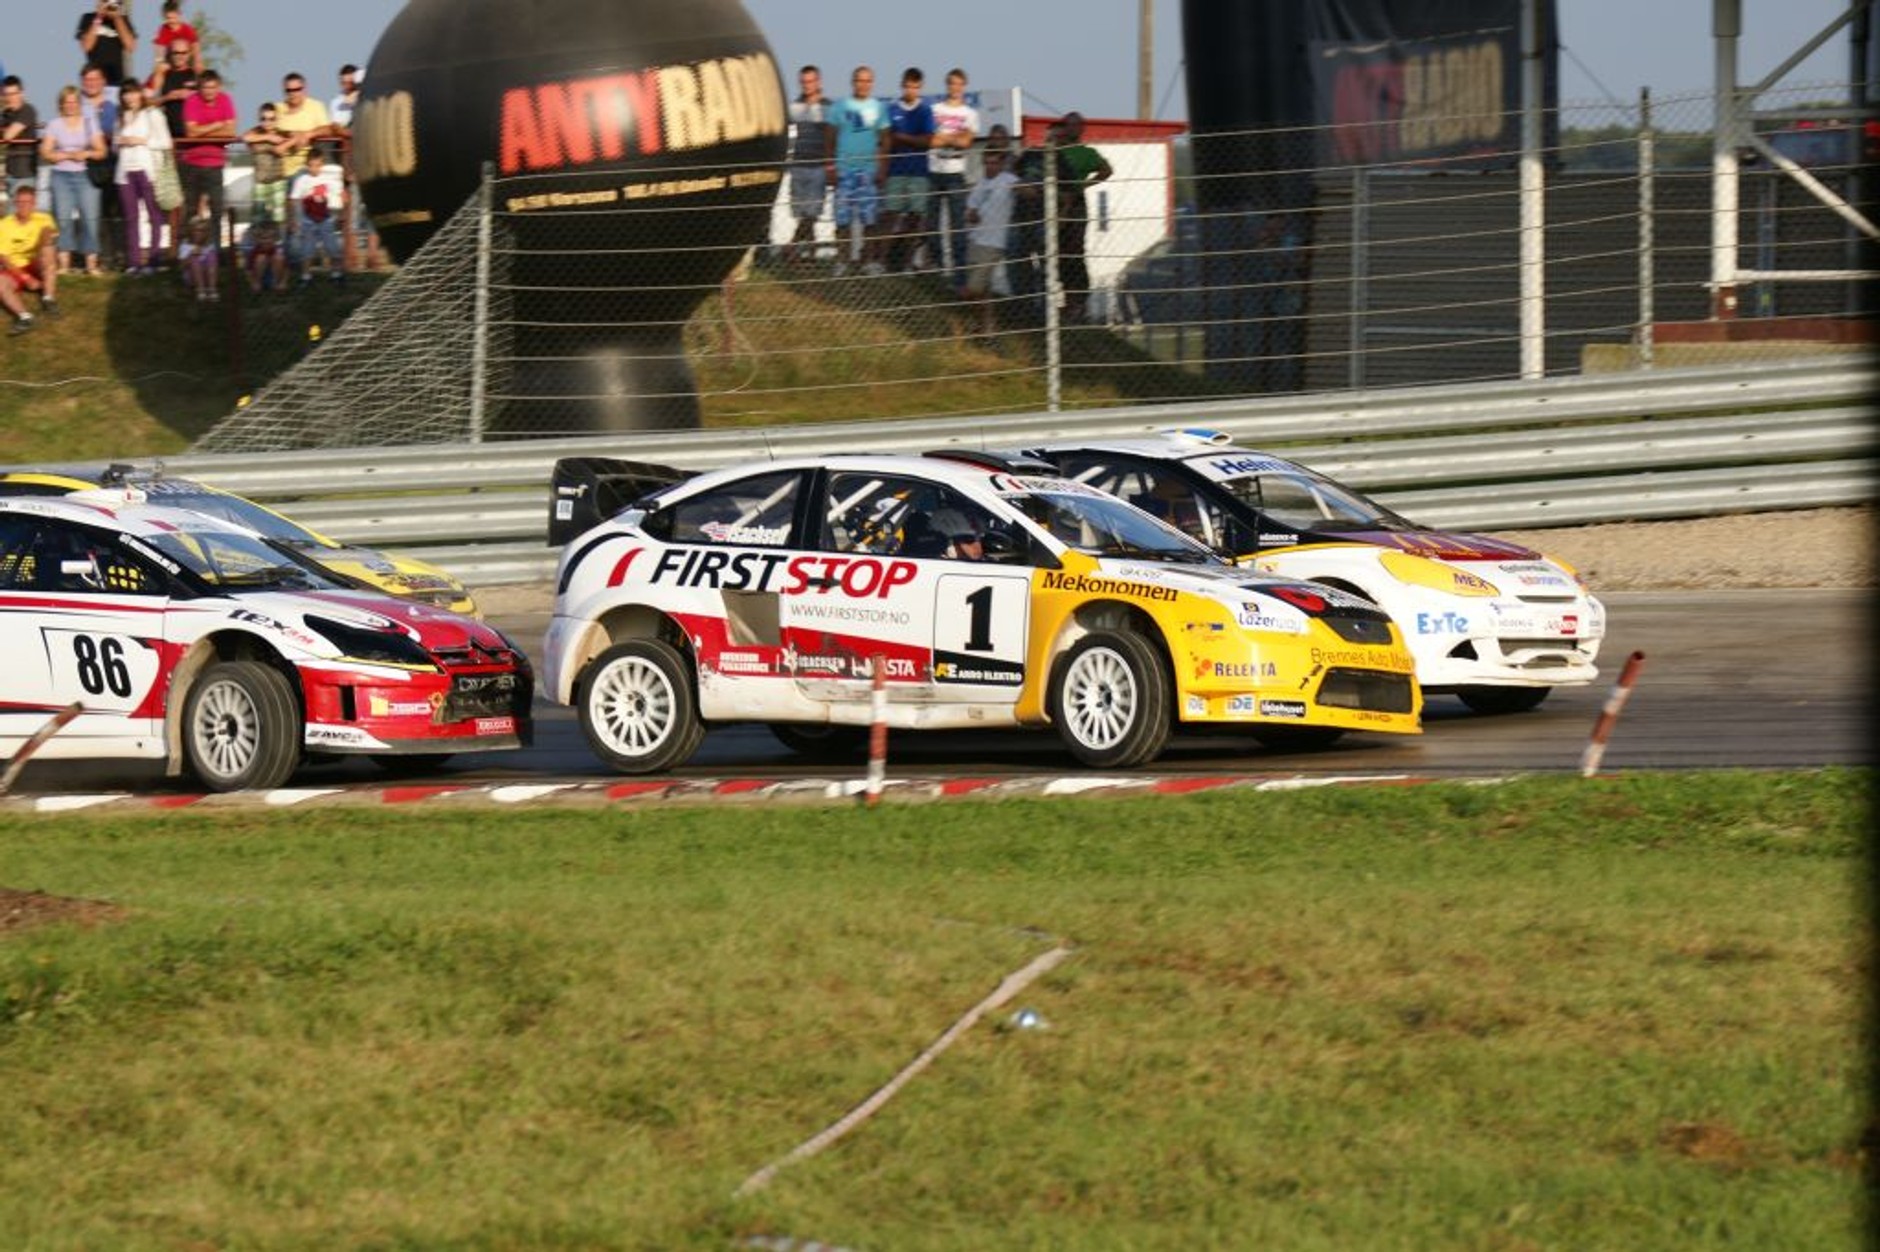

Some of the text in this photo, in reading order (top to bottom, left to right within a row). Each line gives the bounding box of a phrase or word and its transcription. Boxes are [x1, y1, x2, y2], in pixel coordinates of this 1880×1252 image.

[1041, 572, 1179, 602] Mekonomen
[790, 603, 911, 626] WWW.FIRSTSTOP.NO
[963, 585, 994, 652] 1
[1416, 611, 1470, 635] ExTe
[73, 633, 132, 698] 86
